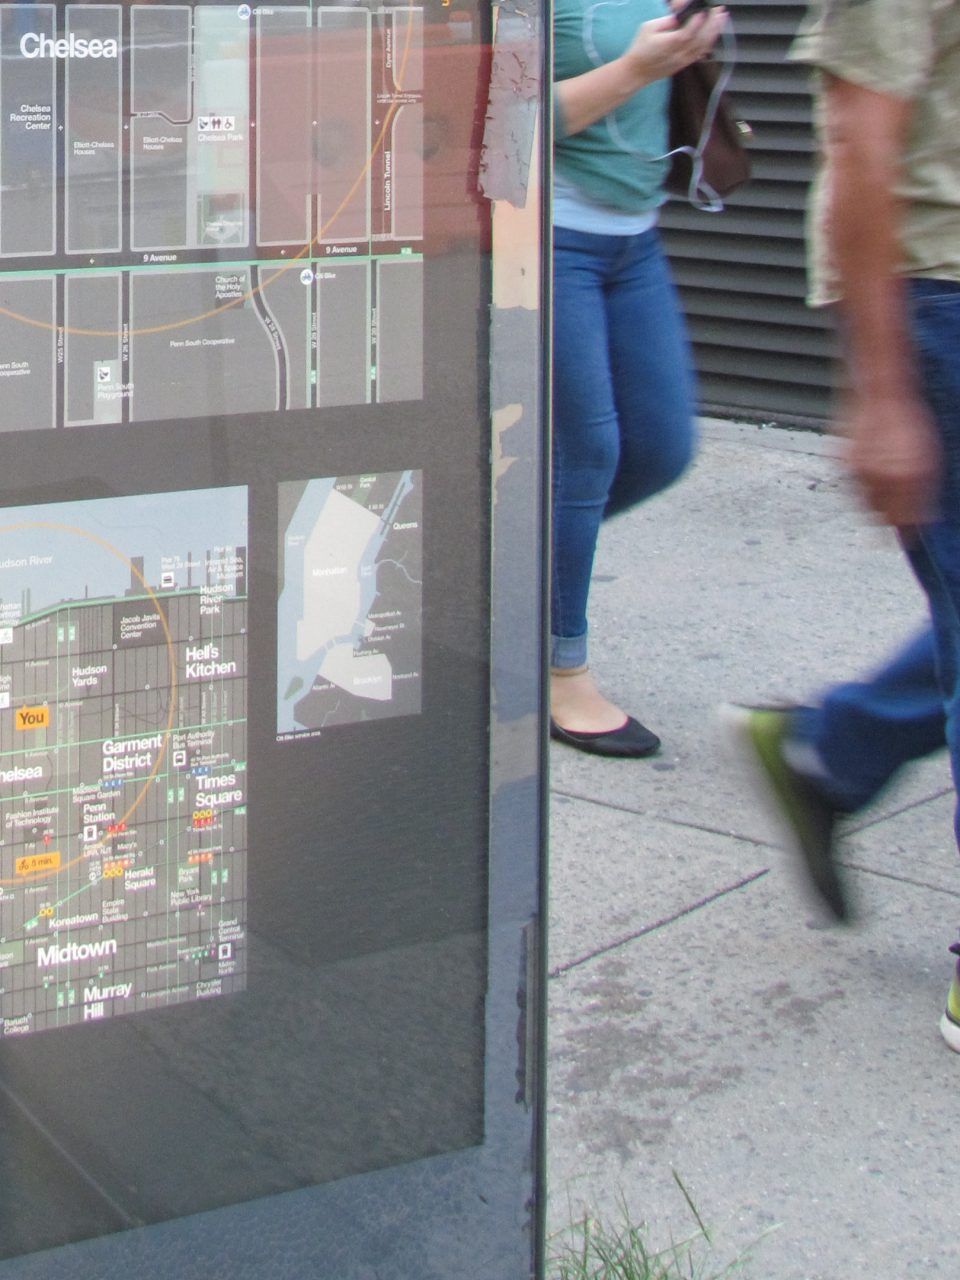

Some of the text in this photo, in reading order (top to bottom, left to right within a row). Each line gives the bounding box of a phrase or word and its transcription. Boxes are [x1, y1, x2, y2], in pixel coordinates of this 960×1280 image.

[19, 32, 118, 59] Chelsea
[20, 104, 51, 114] Chelsea
[10, 113, 51, 122] Recreation
[25, 122, 51, 131] Center
[197, 133, 243, 142] Chelsea Park
[333, 245, 357, 254] Avenue
[150, 253, 177, 262] Avenue
[215, 275, 236, 284] Church
[215, 282, 241, 292] the Holy
[215, 290, 242, 300] Apostles
[393, 521, 418, 530] Queens
[29, 555, 53, 565] River
[120, 615, 140, 625] Jacob
[120, 621, 157, 632] Convention
[120, 630, 142, 640] Center
[186, 643, 219, 662] Hell's
[72, 665, 107, 677] Hudson
[186, 660, 236, 679] Kitchen
[72, 676, 98, 688] Yards
[21, 711, 45, 725] You
[103, 734, 162, 756] Garment
[103, 752, 152, 772] District
[196, 774, 236, 790] Times
[195, 789, 243, 808] Square
[83, 803, 107, 814] Penn
[83, 812, 116, 824] Station
[124, 867, 154, 880] Herald
[124, 877, 156, 891] Square
[102, 898, 124, 908] Empire
[102, 906, 119, 915] State
[49, 912, 98, 928] Koreatown
[102, 912, 129, 923] Building
[37, 939, 117, 968] Midtown
[83, 982, 132, 1004] Murray
[84, 1001, 104, 1019] Hill
[4, 1017, 28, 1027] Baruch
[4, 1024, 30, 1036] College
